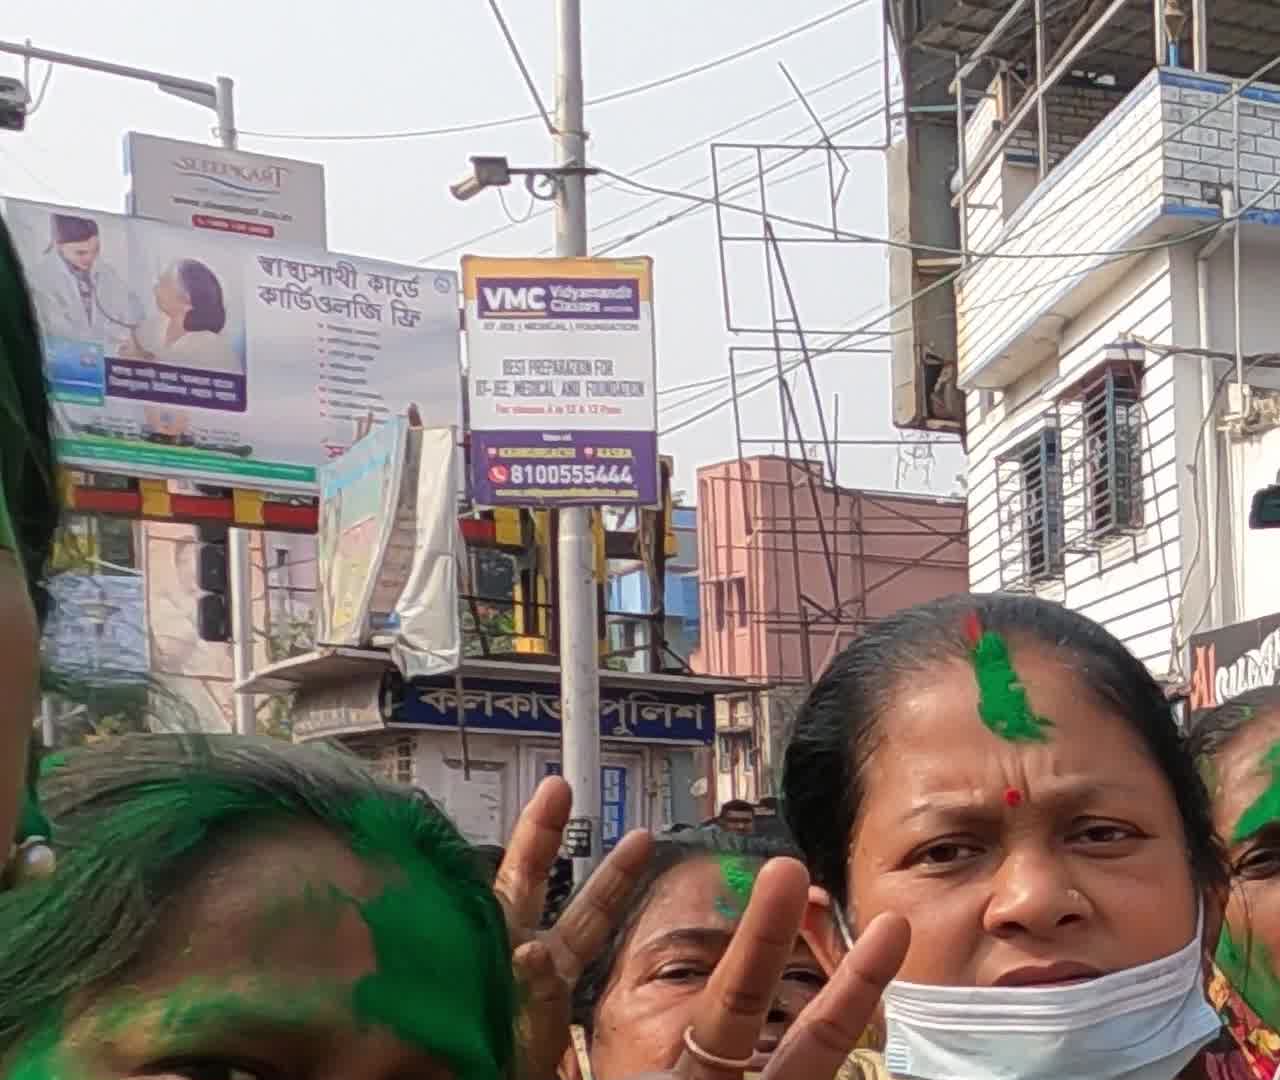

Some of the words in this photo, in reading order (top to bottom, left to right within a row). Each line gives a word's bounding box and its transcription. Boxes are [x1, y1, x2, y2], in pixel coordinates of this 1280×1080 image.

[483, 287, 546, 310] VMC
[511, 464, 633, 484] 8100555444
[420, 688, 562, 721] কলকাত
[602, 693, 706, 735] পুলিশ
